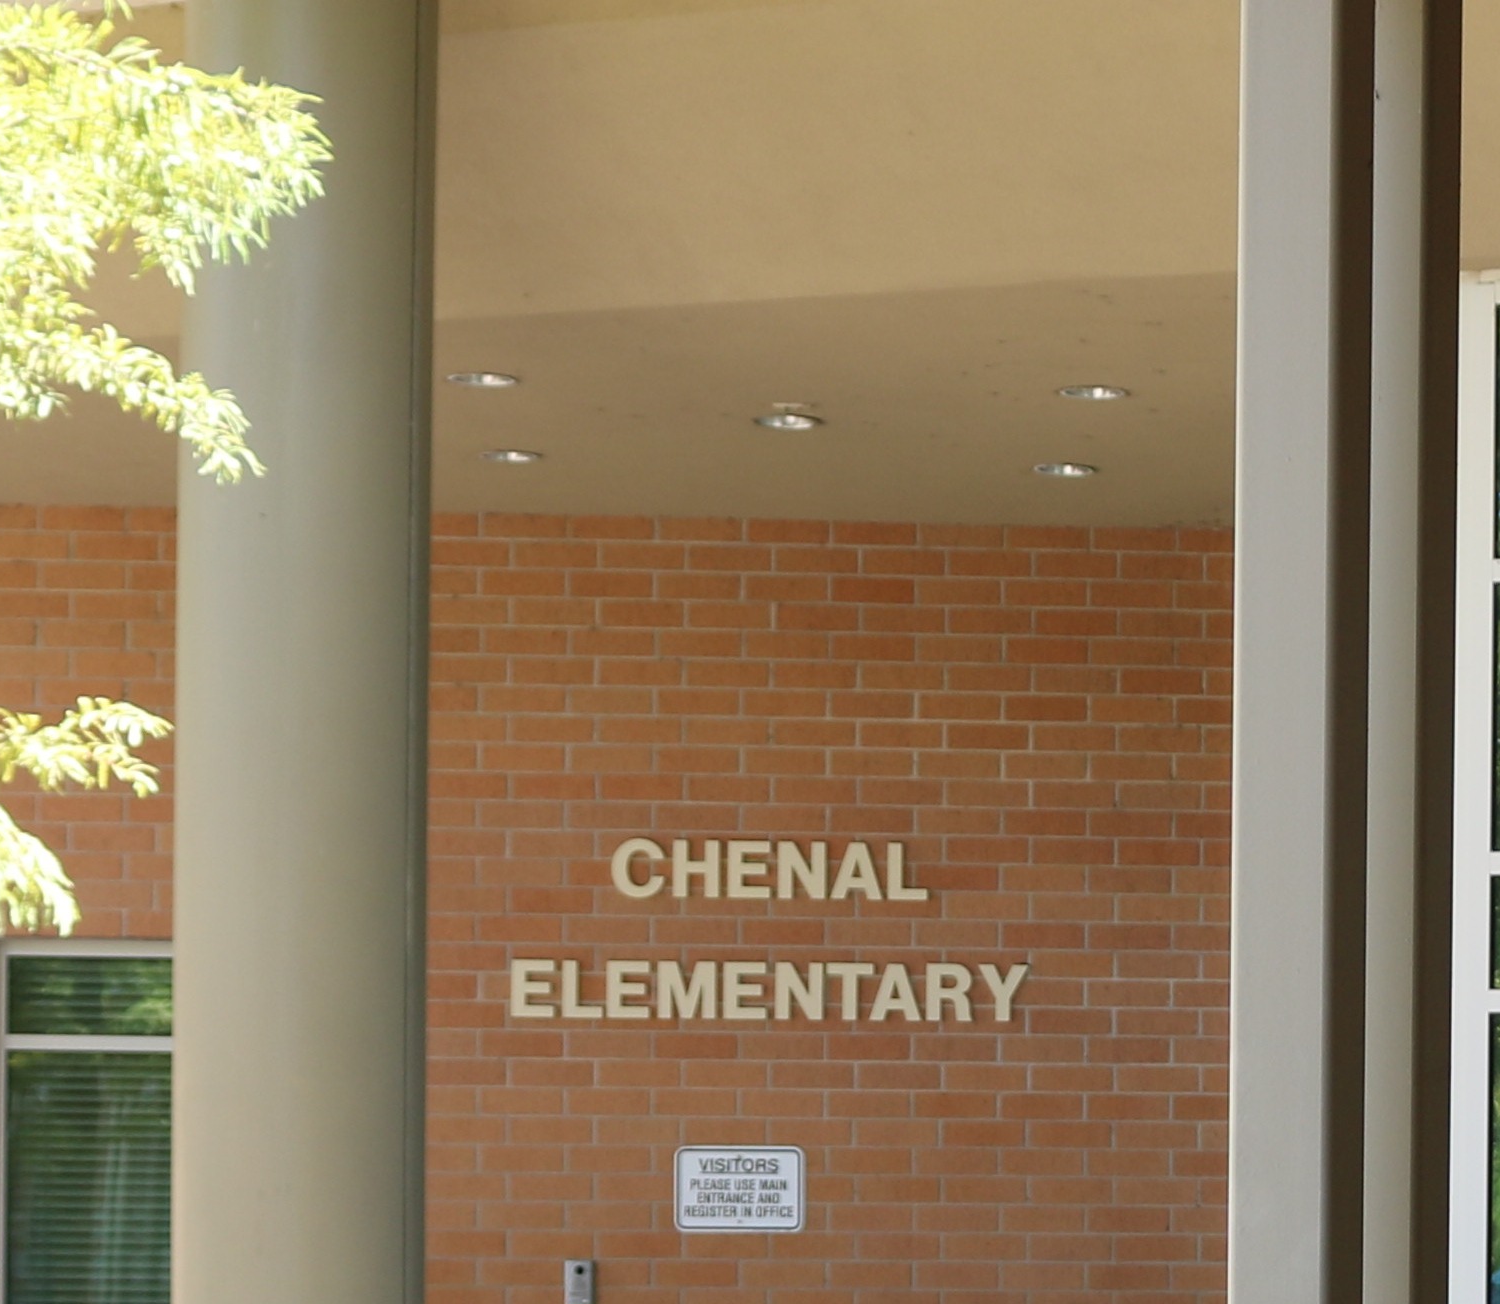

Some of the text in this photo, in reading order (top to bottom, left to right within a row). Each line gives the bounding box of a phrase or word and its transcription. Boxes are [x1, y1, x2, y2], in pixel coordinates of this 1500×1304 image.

[611, 837, 928, 900] CHENAL
[510, 958, 1030, 1022] ELEMENTARY
[699, 1158, 779, 1172] VISITORS
[690, 1178, 787, 1190] PLEASE USE MAIN
[697, 1191, 780, 1204] ENTRANCE AND
[684, 1205, 794, 1218] REGISTER IN OFFICE
